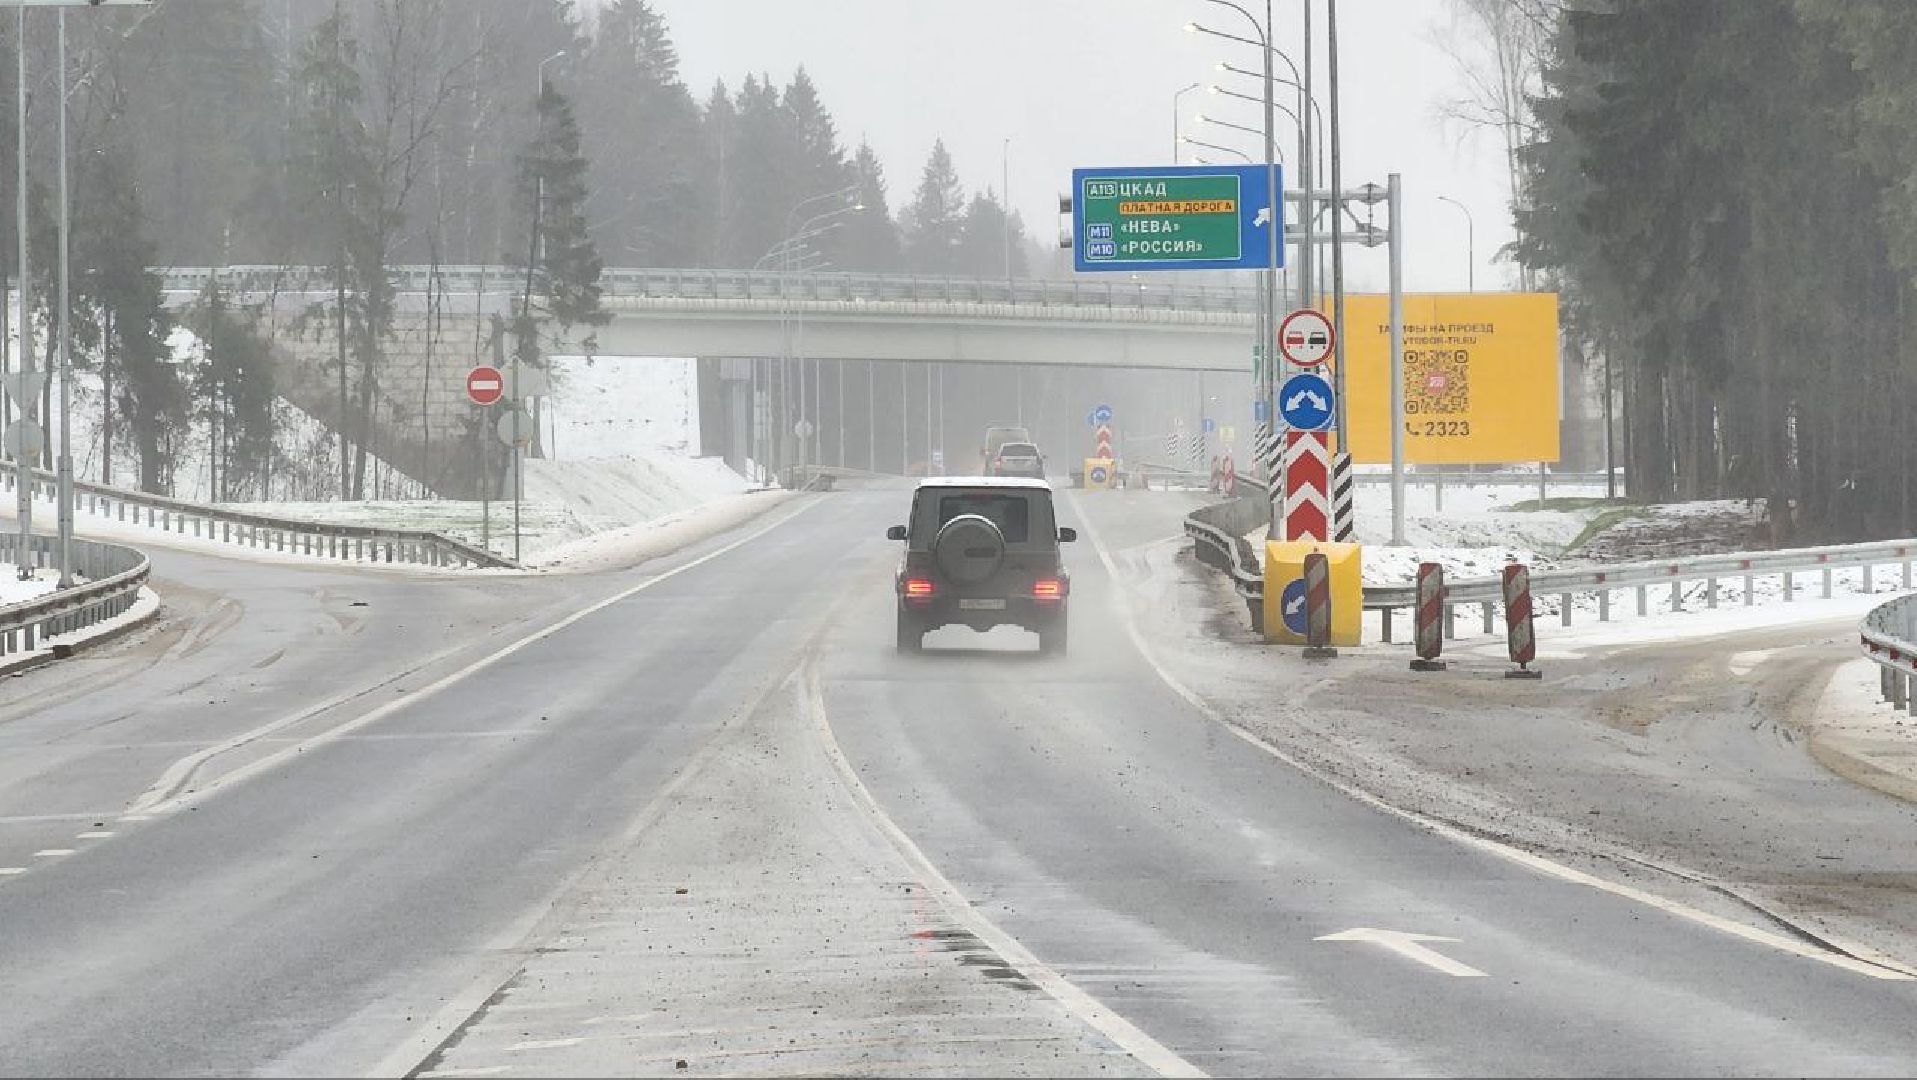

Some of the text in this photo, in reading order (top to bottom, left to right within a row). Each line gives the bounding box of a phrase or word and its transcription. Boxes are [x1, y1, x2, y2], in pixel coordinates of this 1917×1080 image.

[1090, 182, 1167, 197] А113 ЦКАД
[1121, 202, 1233, 214] ПЛАТНАЯ ДОРОГА
[1090, 220, 1180, 237] М11 «НЕВА»
[1090, 240, 1203, 255] М10 «РОССИЯ»
[1379, 323, 1494, 335] ТАФЫ НА ПРОЕЗД
[1424, 421, 1470, 436] 2323
